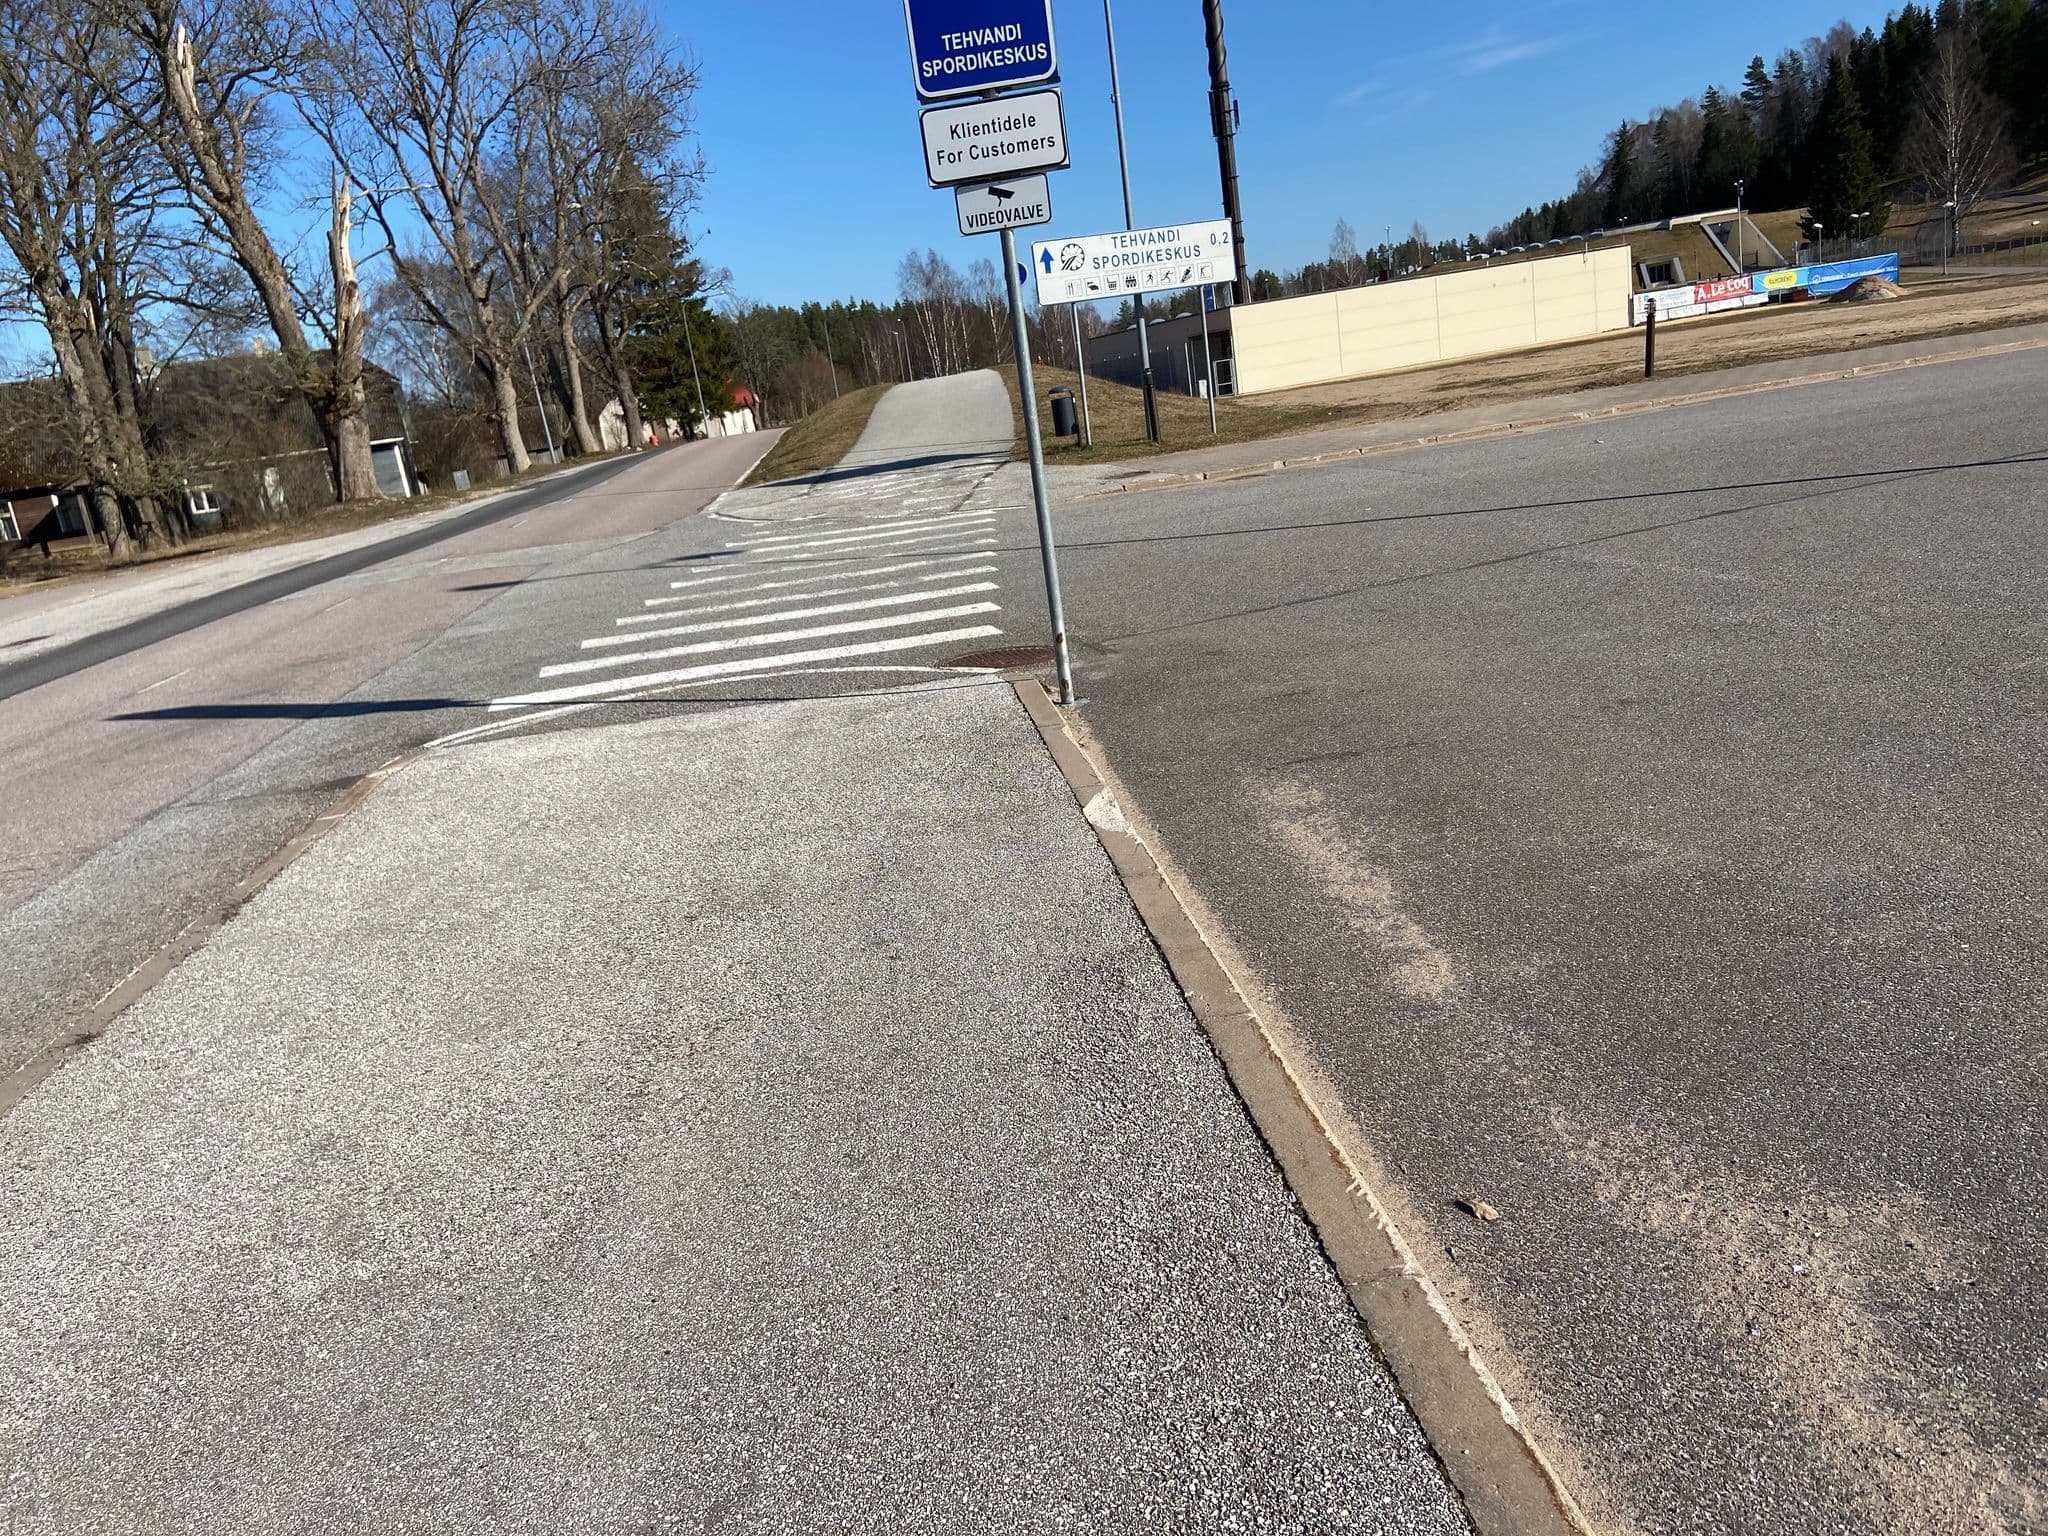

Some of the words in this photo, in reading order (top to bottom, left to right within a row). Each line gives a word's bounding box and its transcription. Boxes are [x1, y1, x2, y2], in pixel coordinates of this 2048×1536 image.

[941, 23, 1022, 51] TEHVANDI
[922, 42, 1048, 78] SPORDIKESKUS
[949, 113, 1036, 140] Klientidele
[936, 149, 963, 165] For
[969, 135, 1056, 160] Customers
[966, 204, 1044, 228] VIDEOVALVE
[1111, 228, 1181, 249] TEHVANDI
[1092, 244, 1201, 270] SPORDIKESKUS
[1727, 277, 1750, 292] Coq
